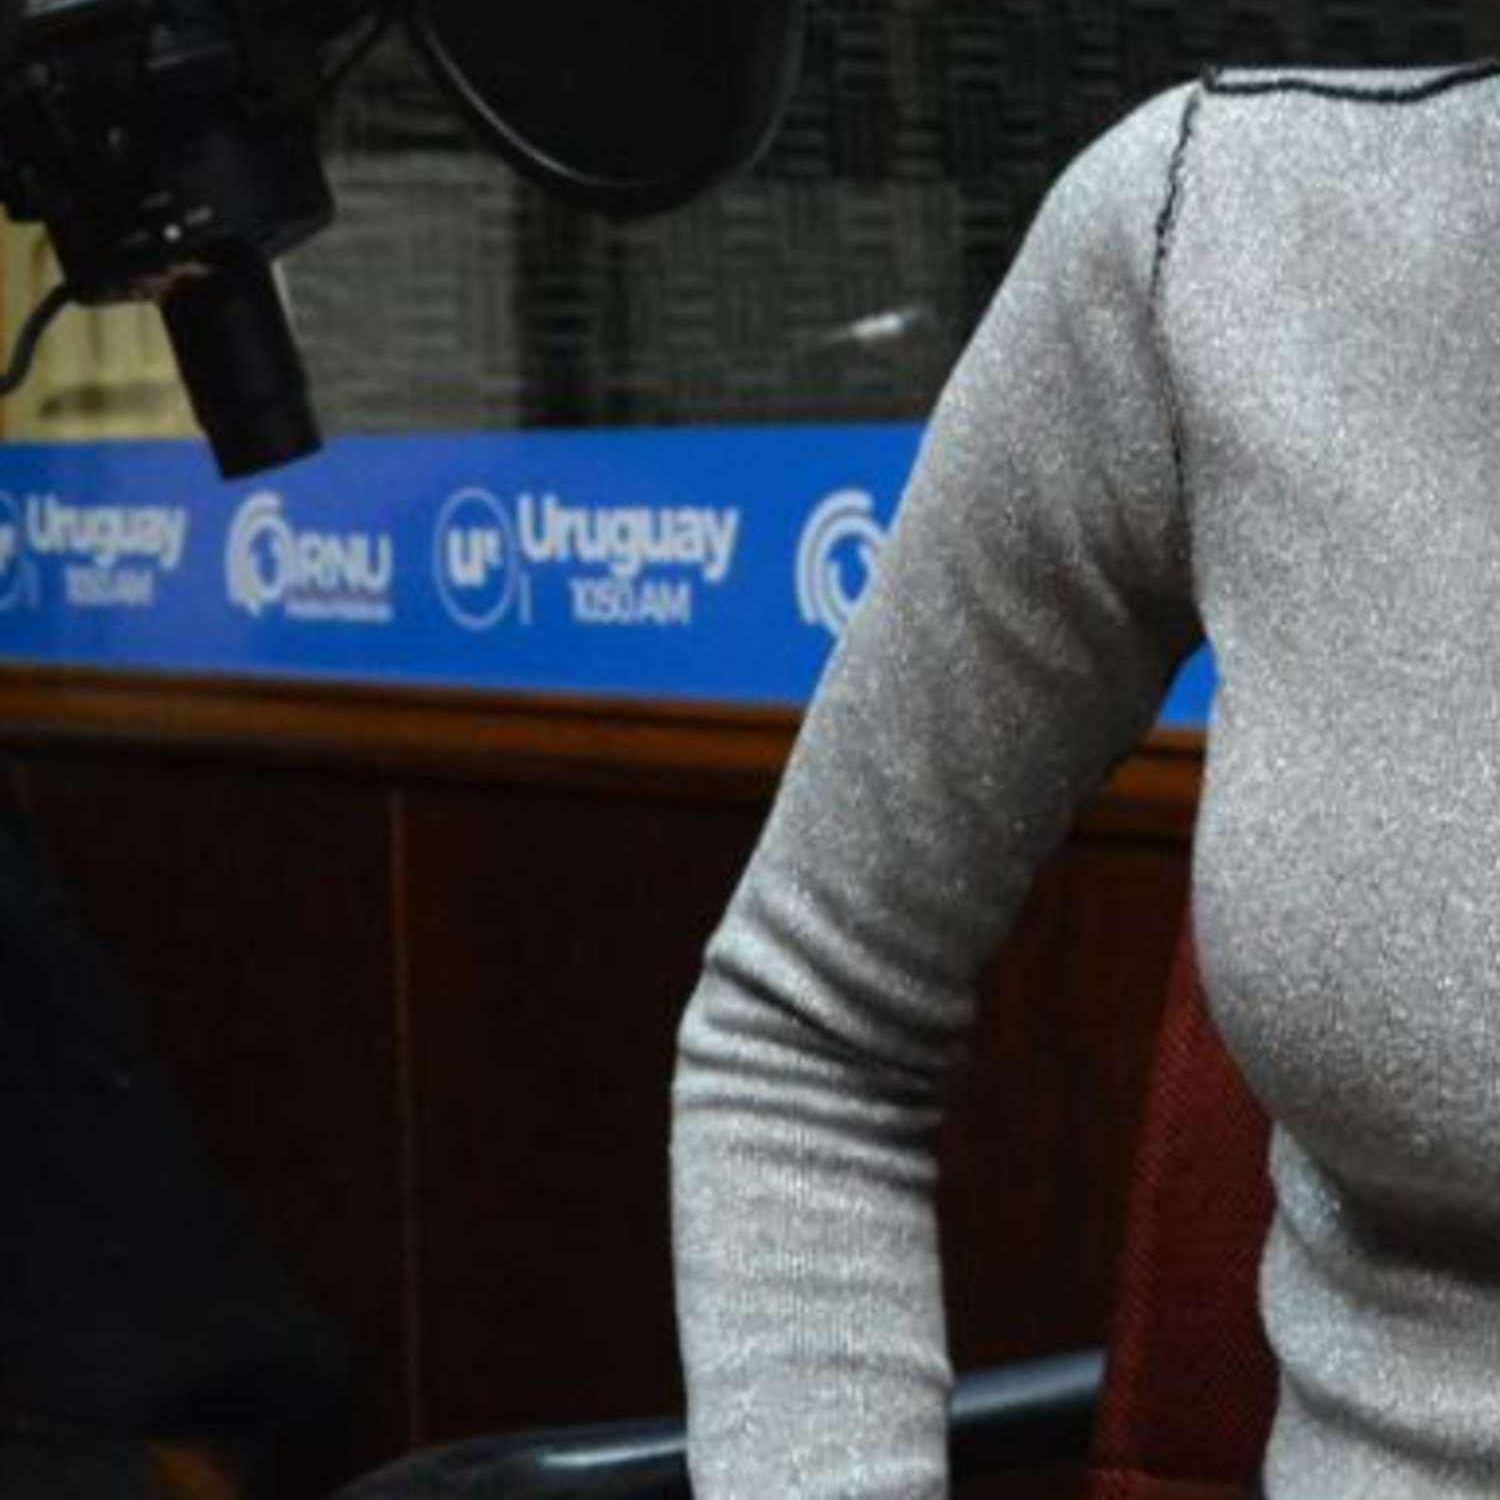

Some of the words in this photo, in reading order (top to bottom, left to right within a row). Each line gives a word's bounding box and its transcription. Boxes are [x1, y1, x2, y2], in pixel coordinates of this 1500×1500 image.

[27, 493, 187, 568] Uruguay
[297, 531, 394, 592] RNU
[516, 494, 740, 582] Uruguay
